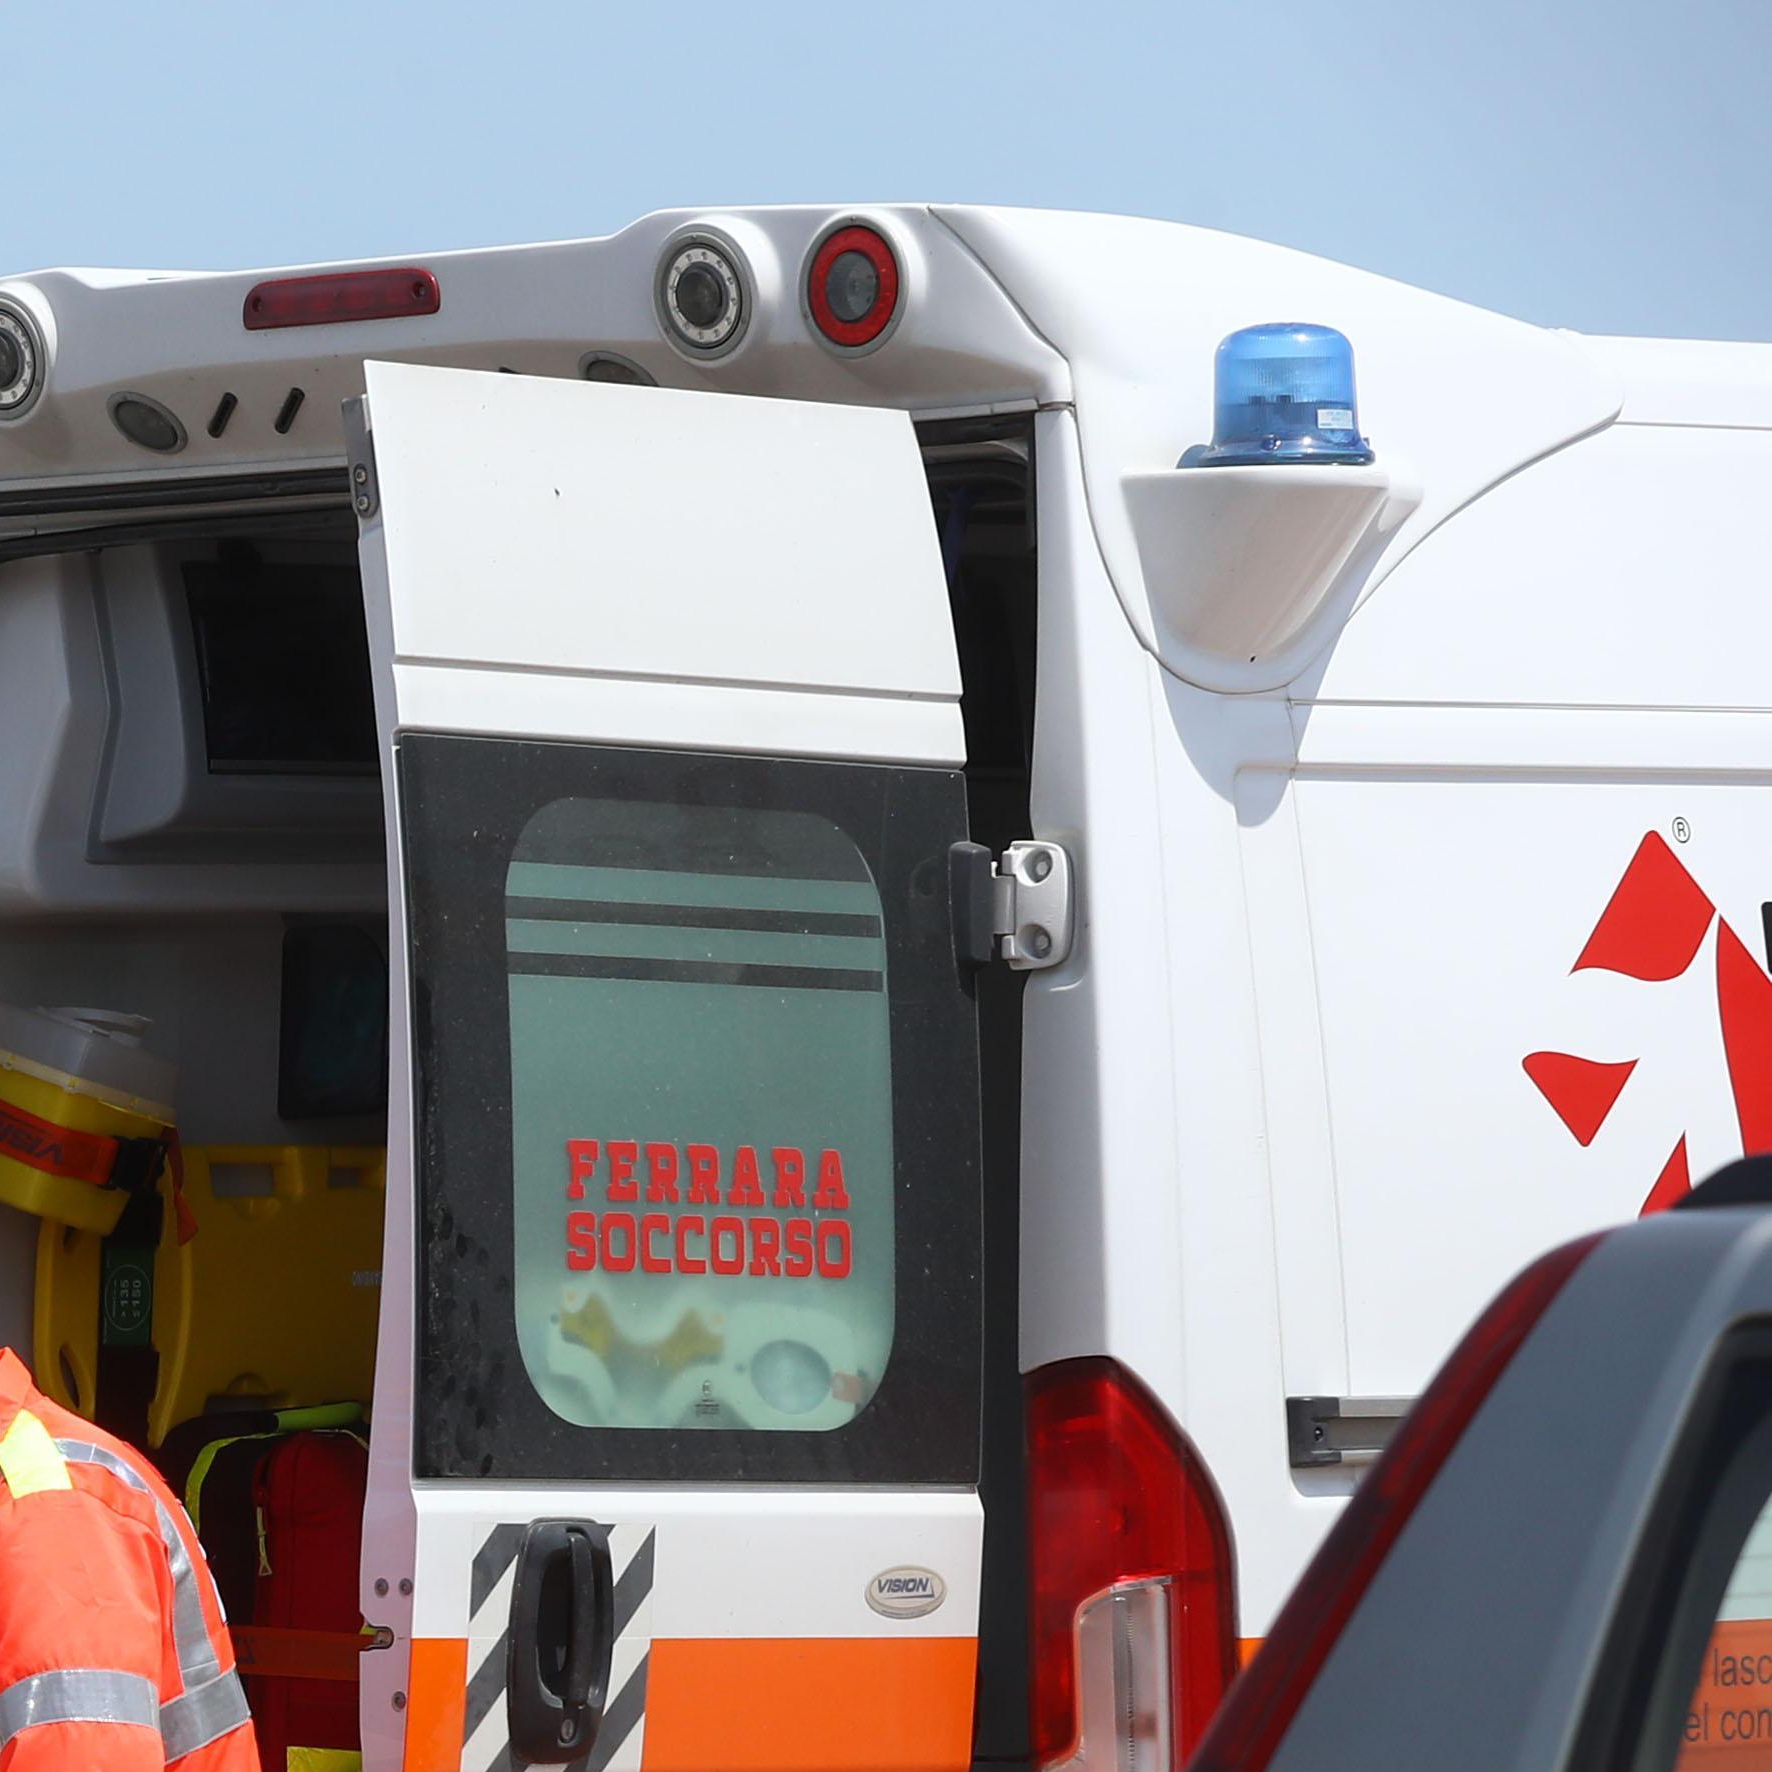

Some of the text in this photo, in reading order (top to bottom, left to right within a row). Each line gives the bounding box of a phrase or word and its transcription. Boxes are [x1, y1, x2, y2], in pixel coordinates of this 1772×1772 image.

[566, 1138, 850, 1210] FERRARA
[566, 1211, 852, 1278] SOCCORSO
[877, 1577, 930, 1594] VISION
[1713, 1647, 1772, 1688] lasc
[1684, 1702, 1709, 1742] el
